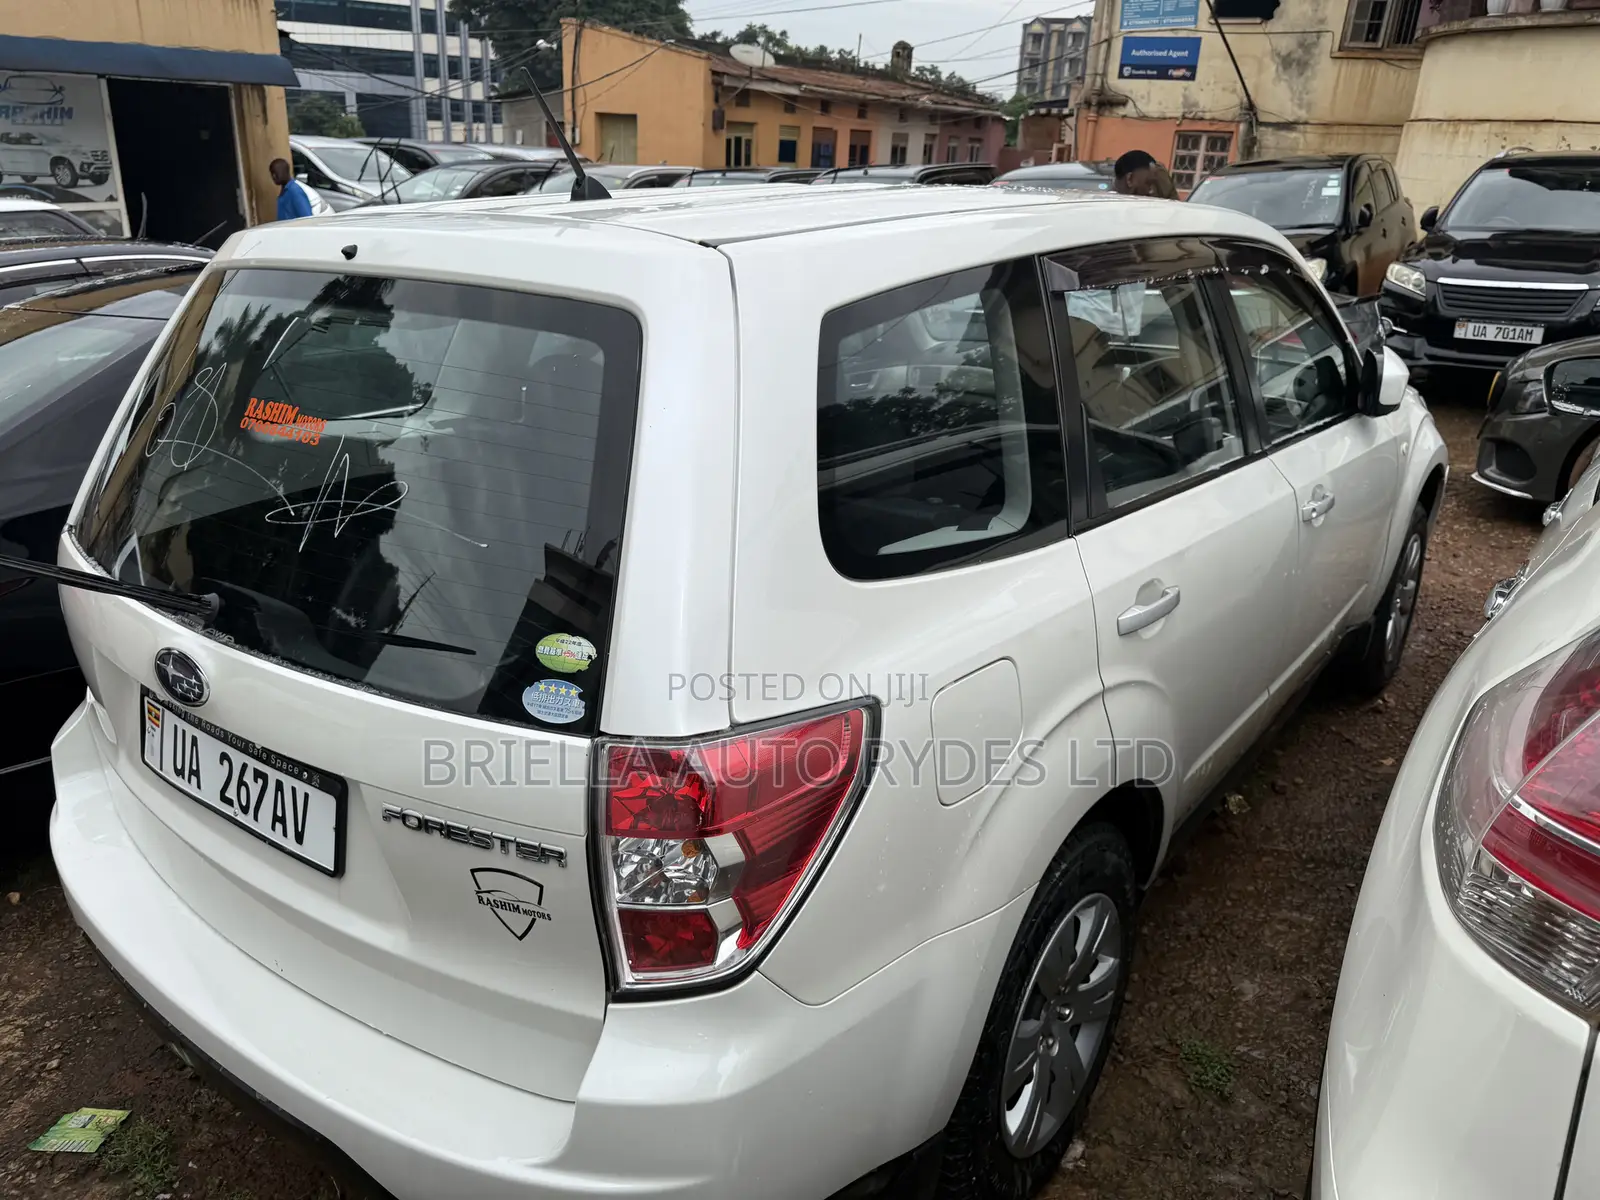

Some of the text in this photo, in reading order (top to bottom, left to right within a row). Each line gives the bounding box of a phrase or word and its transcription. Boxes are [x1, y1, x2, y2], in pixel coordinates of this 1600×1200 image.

[1130, 48, 1189, 58] Authorised Agent
[1472, 324, 1534, 341] UA 701AM
[244, 397, 328, 433] RASHIM MOTORS
[187, 711, 199, 724] the
[201, 719, 225, 738] Roads
[227, 732, 246, 748] Your
[249, 743, 267, 761] Safe
[270, 755, 299, 774] Space
[173, 724, 310, 846] UA 267AV
[382, 802, 568, 868] FORESTER
[476, 894, 552, 922] RASHIM MOTORS
